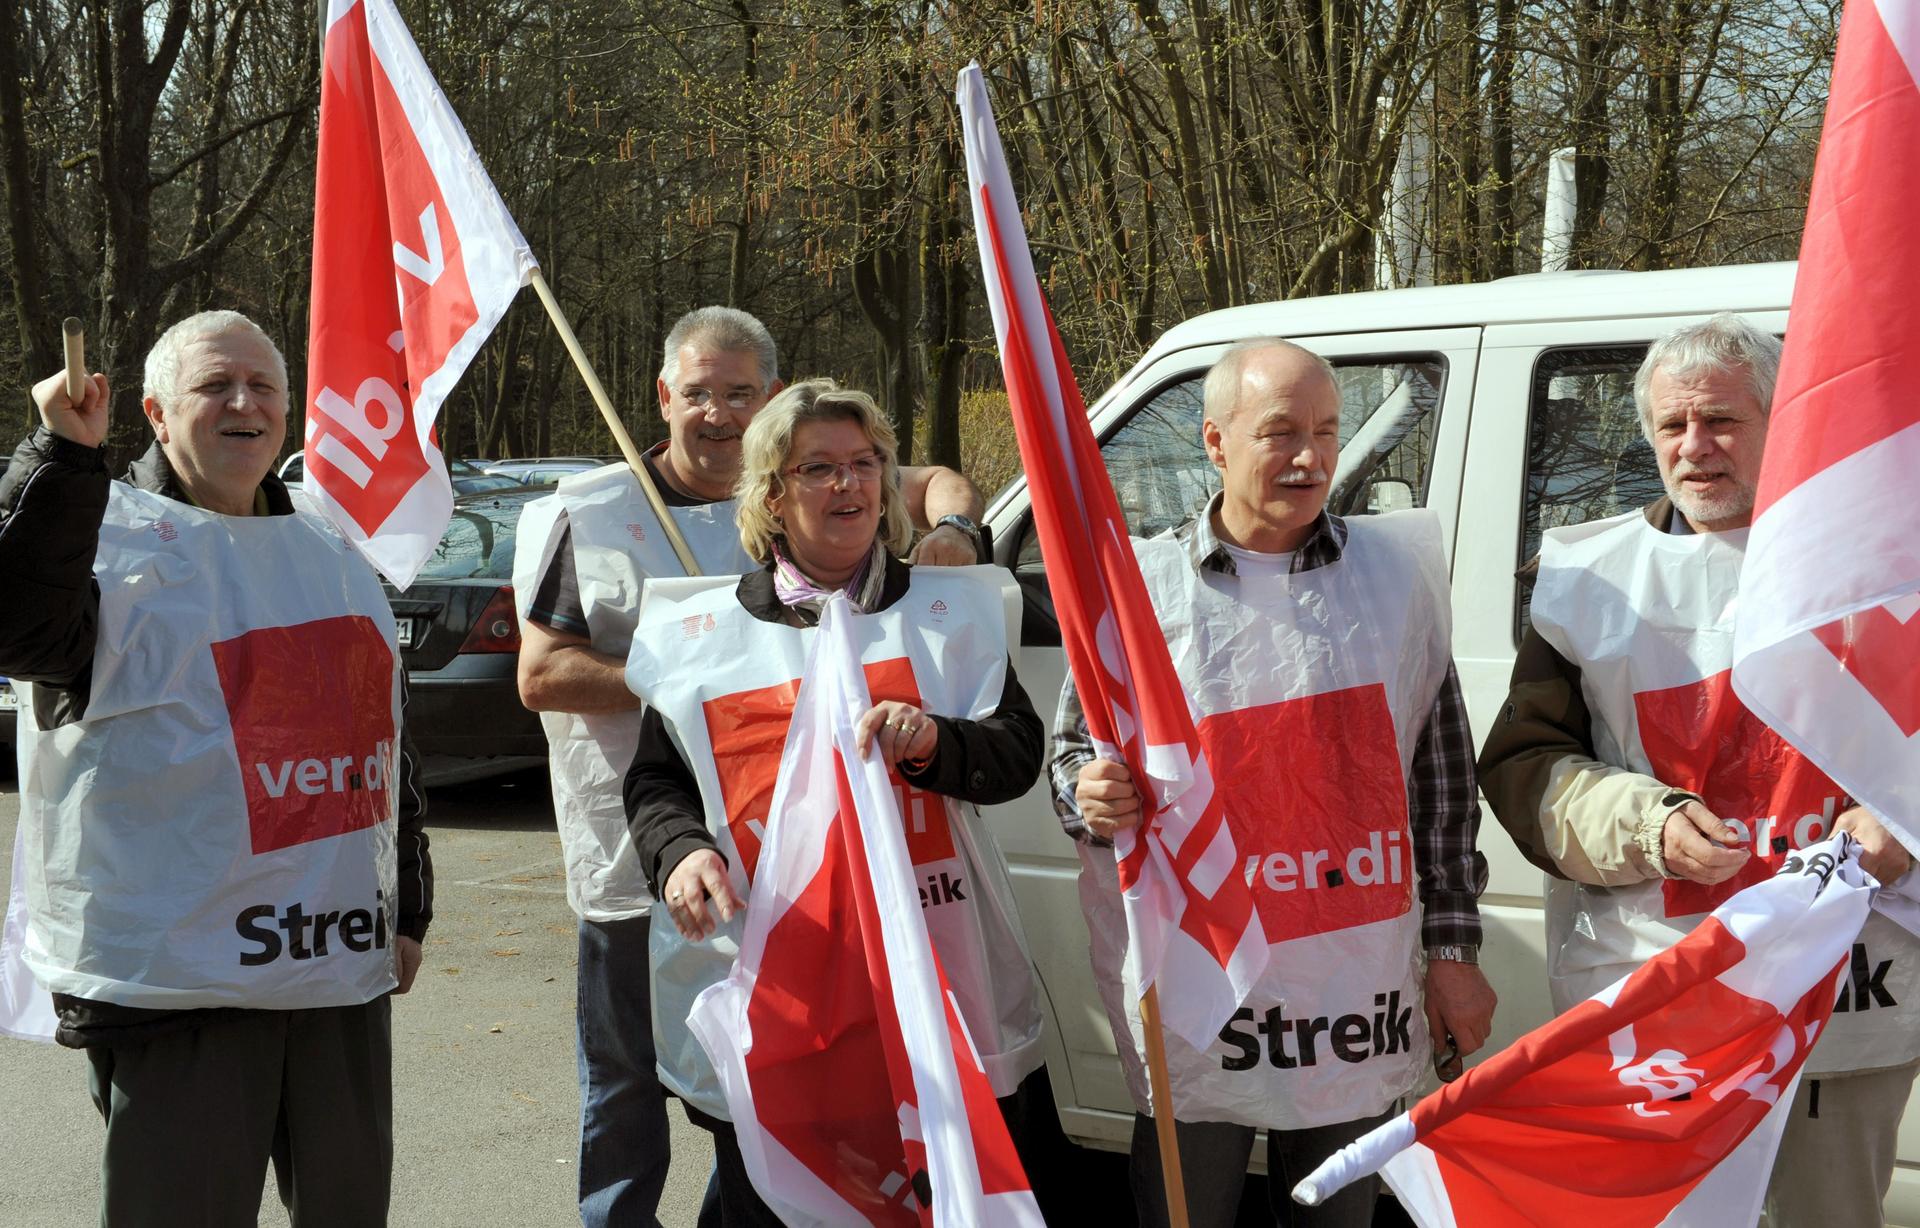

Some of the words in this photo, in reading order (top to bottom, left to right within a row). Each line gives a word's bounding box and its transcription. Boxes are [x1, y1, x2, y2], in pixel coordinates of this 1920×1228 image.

[396, 621, 409, 640] 1
[256, 741, 391, 798] ver.di
[1714, 797, 1849, 858] er.d
[235, 890, 386, 966] Strei
[1218, 990, 1412, 1071] Streik
